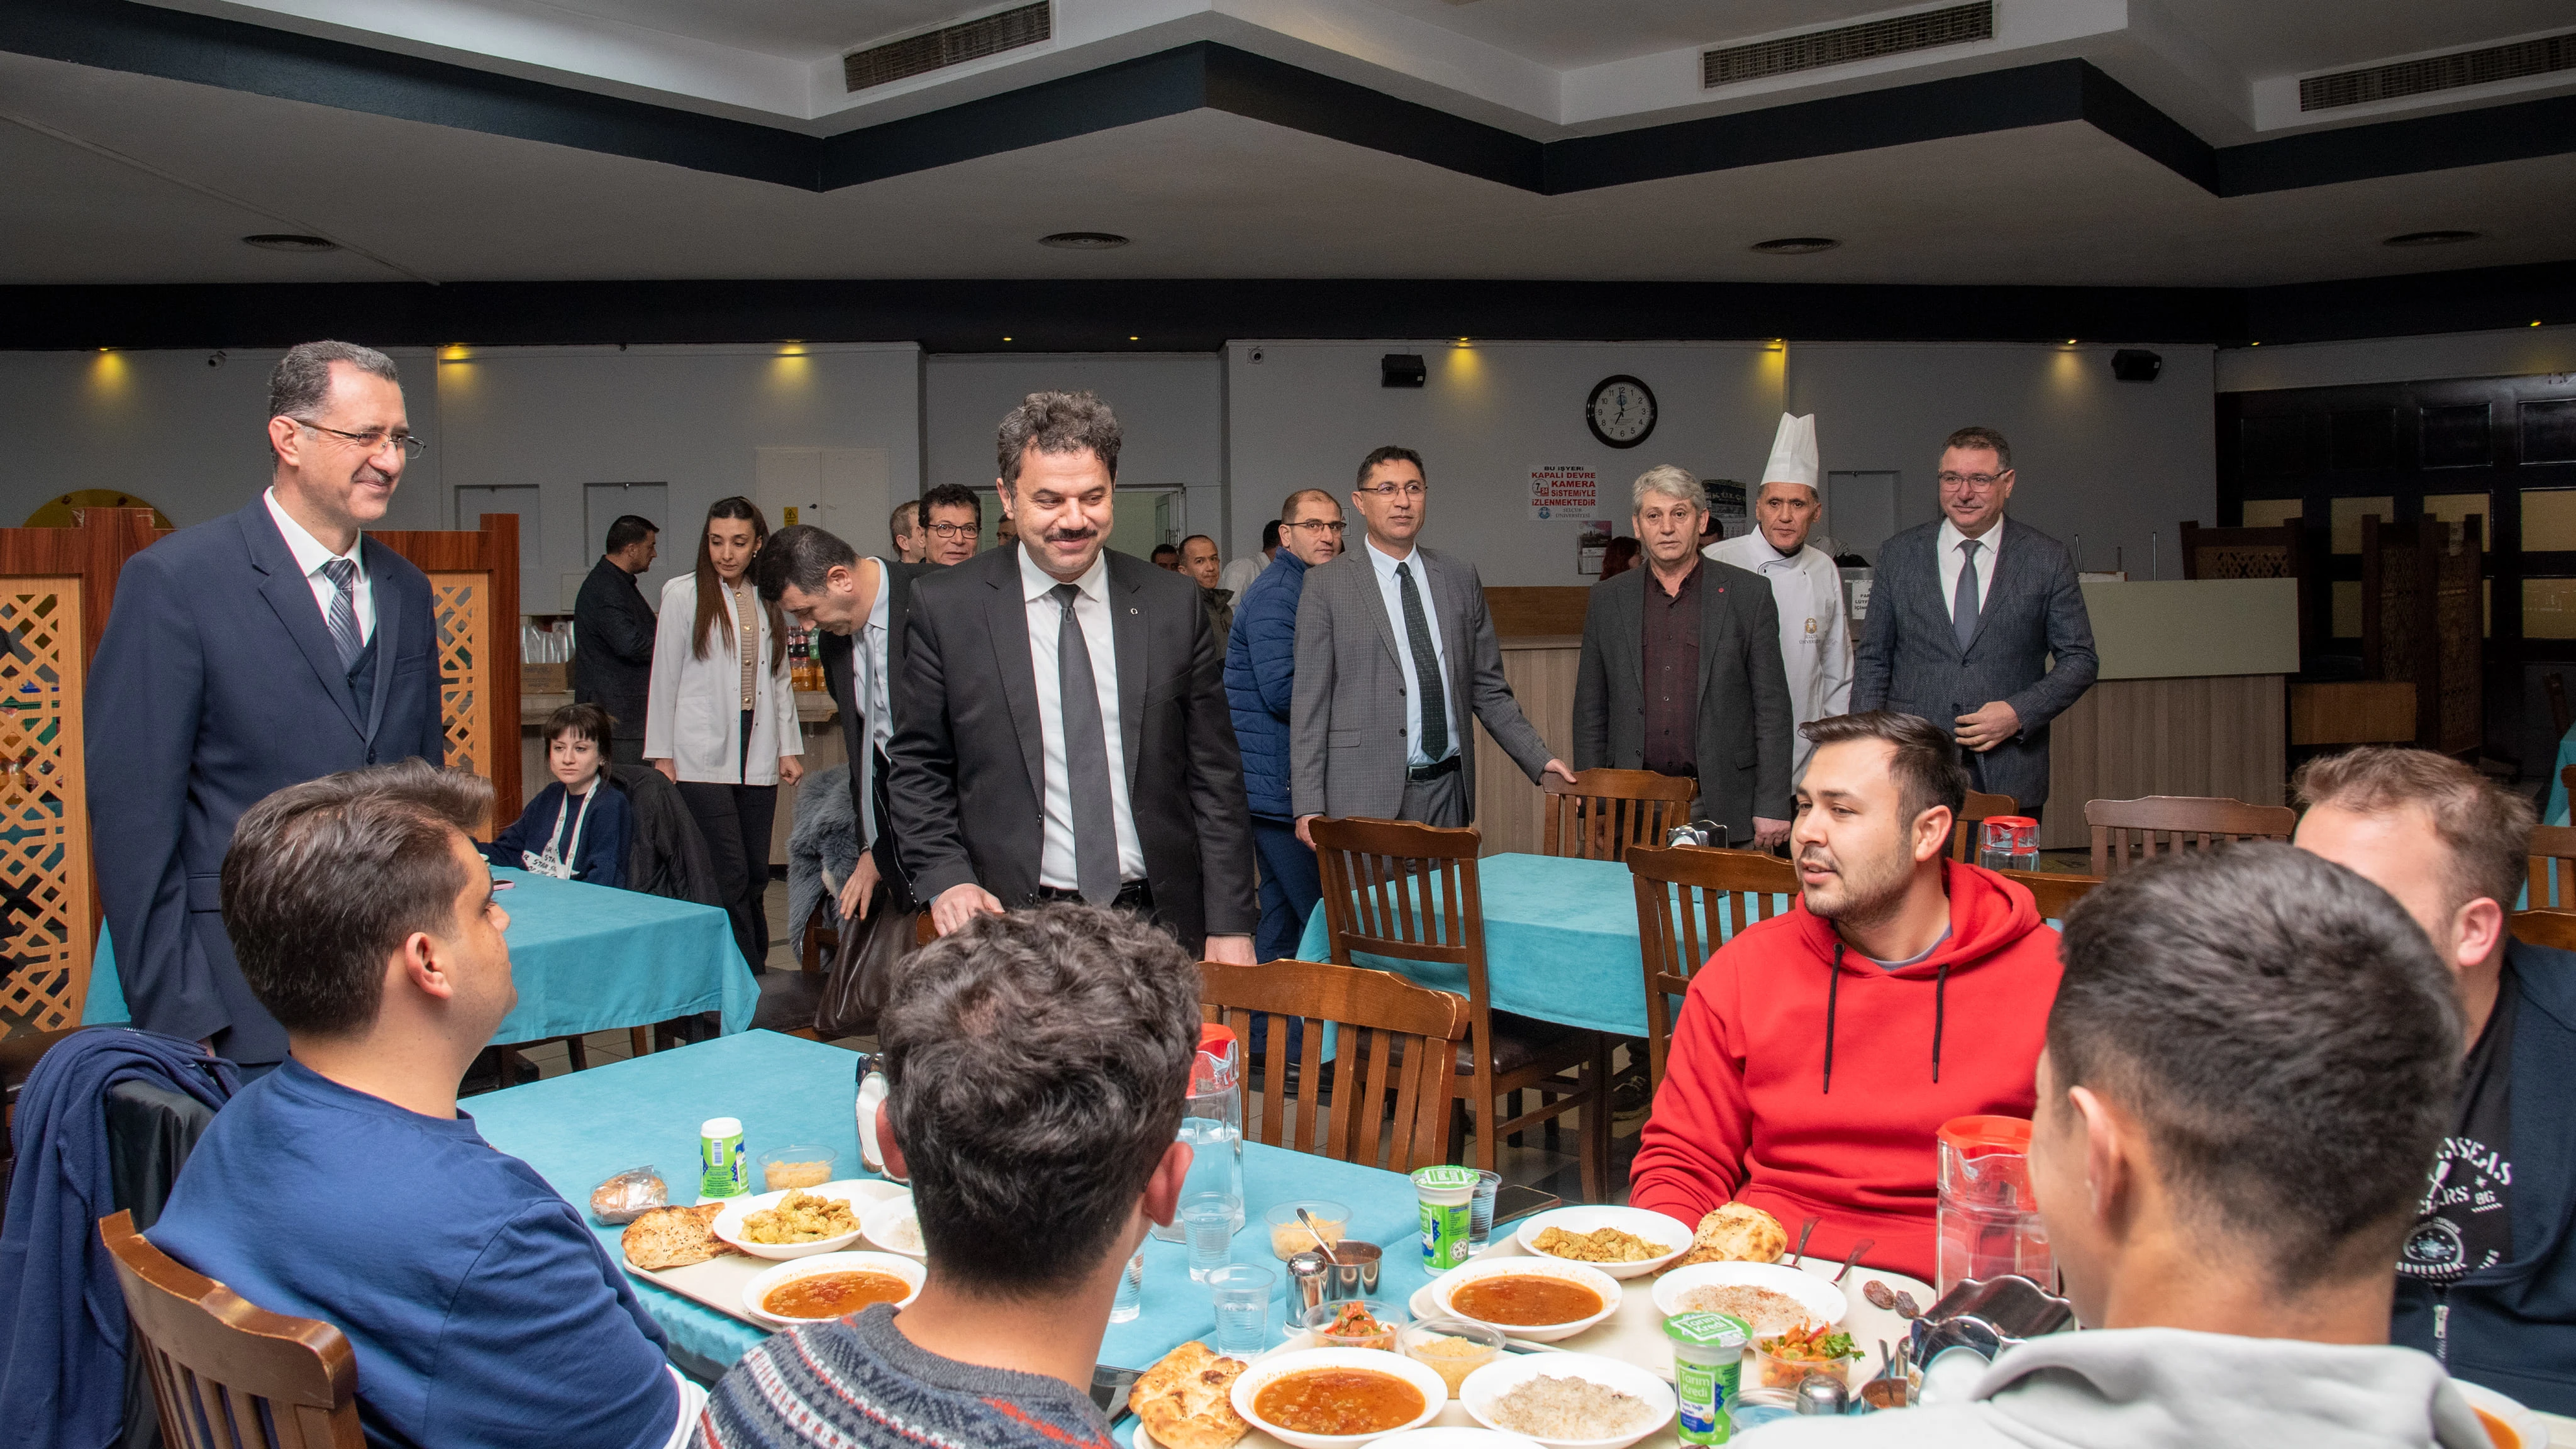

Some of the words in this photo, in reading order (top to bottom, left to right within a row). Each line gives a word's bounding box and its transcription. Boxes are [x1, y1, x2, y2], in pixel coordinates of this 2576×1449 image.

[533, 859, 549, 869] STAR
[1680, 1316, 1721, 1328] Tarım
[1692, 1321, 1728, 1333] Kredi
[1680, 1370, 1710, 1387] Tarım
[1682, 1383, 1707, 1398] Kredi
